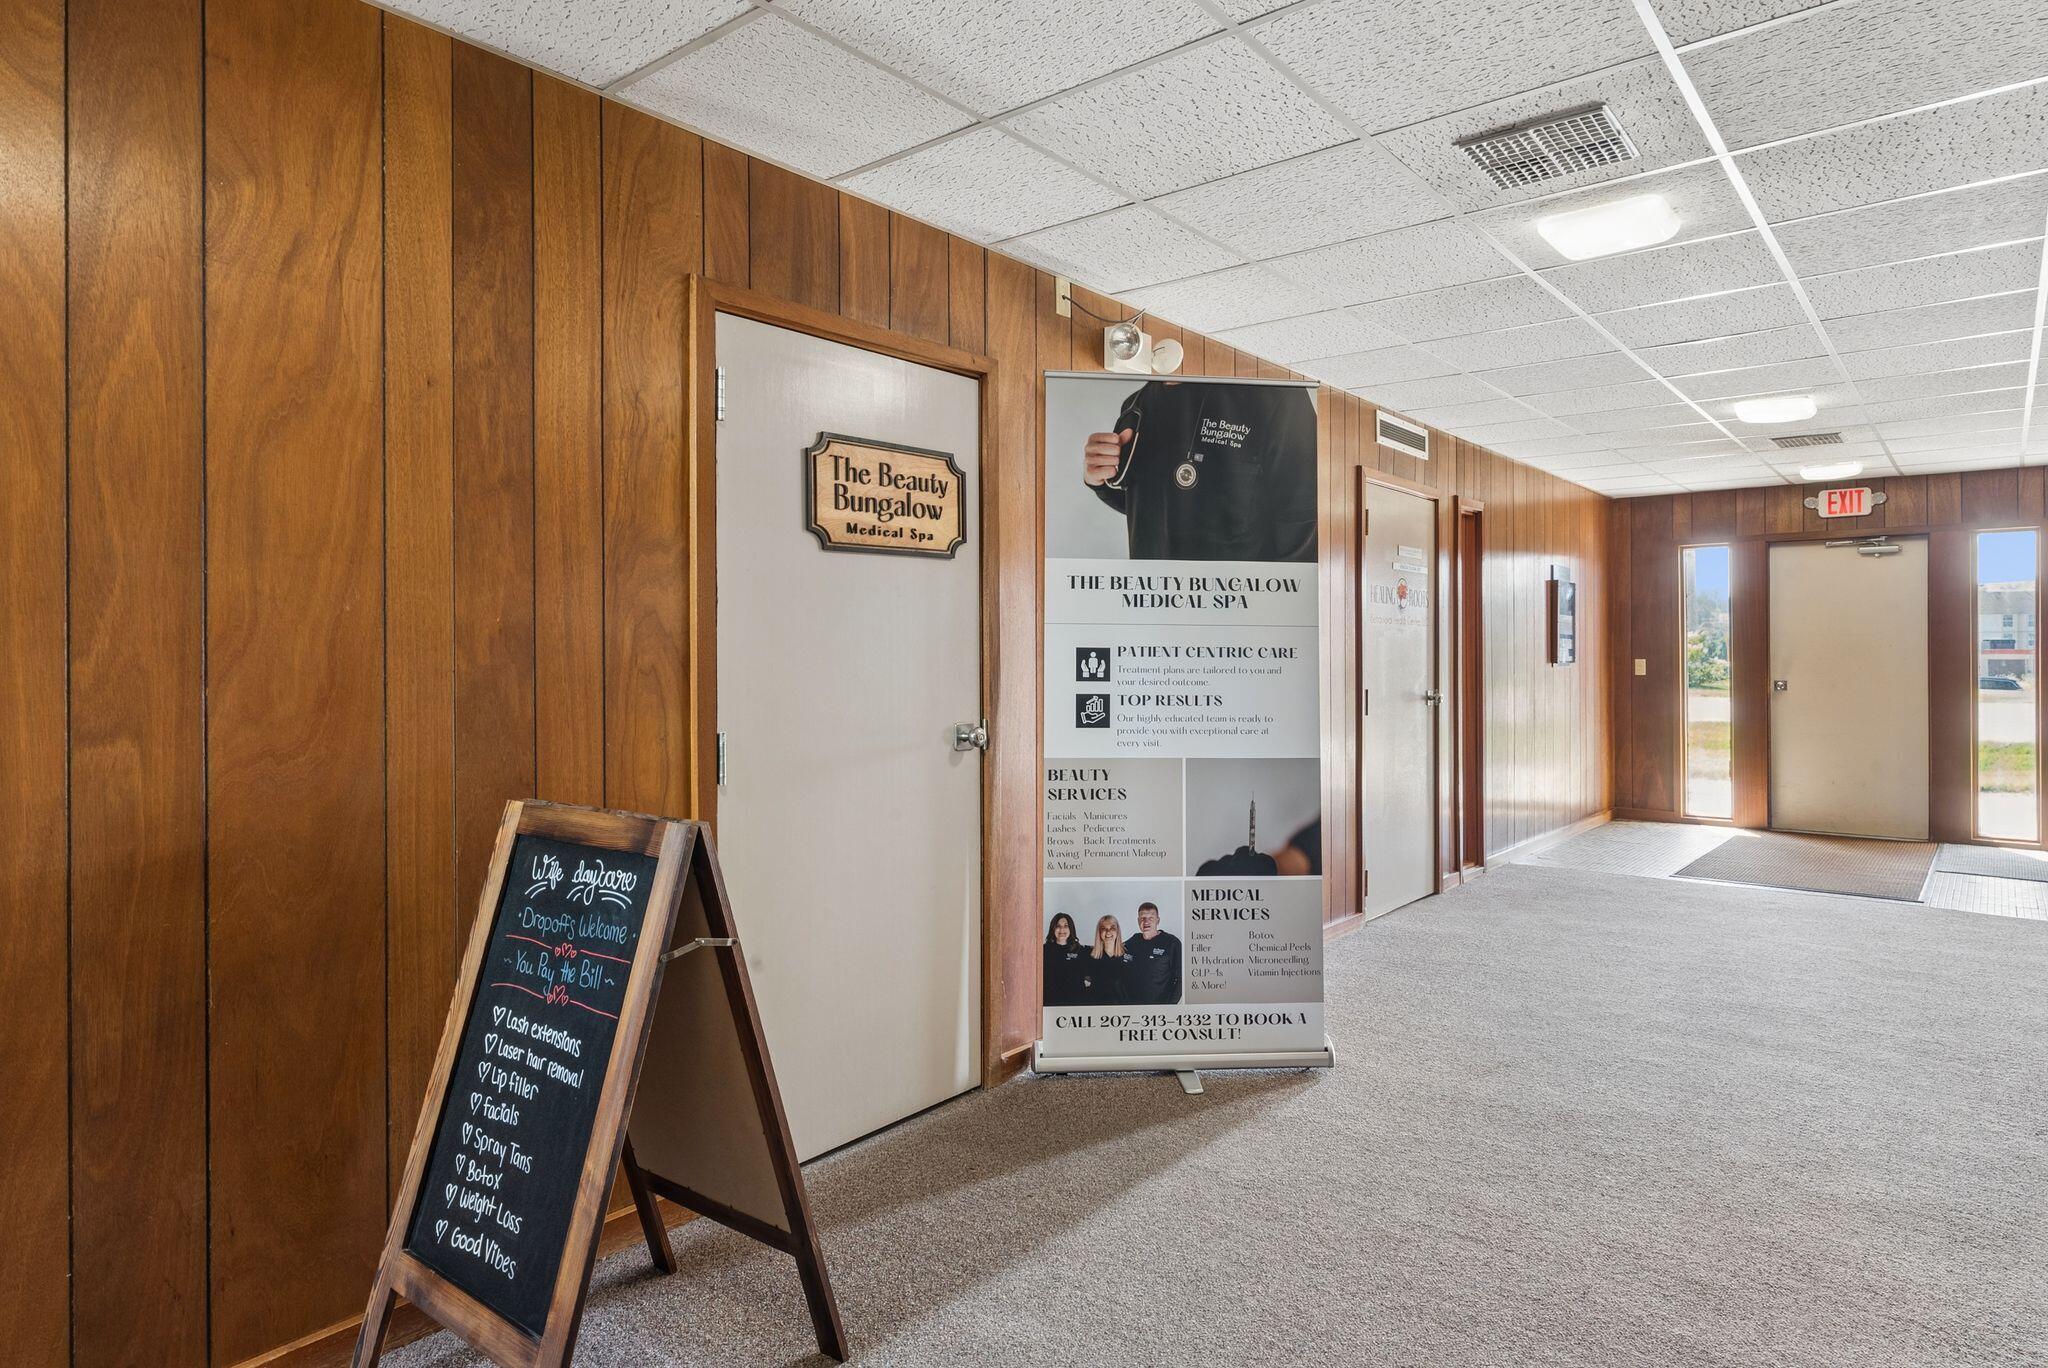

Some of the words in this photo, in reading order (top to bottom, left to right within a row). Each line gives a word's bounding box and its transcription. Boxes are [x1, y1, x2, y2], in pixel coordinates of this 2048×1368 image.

[1202, 418, 1217, 428] The
[1219, 420, 1251, 435] Beauty
[1200, 427, 1245, 440] Bungalow
[1201, 436, 1228, 445] Medical
[829, 454, 871, 485] The
[879, 462, 948, 498] Beauty
[834, 483, 943, 522] Bungalow
[1827, 489, 1864, 515] EXIT
[846, 522, 903, 538] Medical
[910, 528, 934, 542] Spa
[1067, 575, 1105, 590] THE
[1110, 576, 1185, 591] BEAUTY
[1189, 577, 1302, 593] BUNGALOW
[1121, 593, 1207, 609] MEDICAL
[1212, 594, 1249, 609] SPA
[1118, 646, 1181, 658] PATIENT
[1185, 646, 1254, 658] CENTRIC
[1258, 647, 1298, 659] CARE
[1118, 665, 1160, 674] Treatment
[1163, 666, 1185, 675] plans
[1203, 666, 1236, 674] tailored
[1250, 669, 1265, 677] you
[1117, 680, 1135, 688] your
[1138, 677, 1170, 686] desired
[1117, 694, 1151, 706] TOP
[1155, 694, 1223, 707] RESULTS
[1117, 713, 1134, 722] Our
[1137, 714, 1161, 724] highly
[1164, 714, 1204, 722] educated
[1229, 715, 1236, 723] is
[1238, 714, 1261, 724] ready
[1117, 727, 1150, 736] provide
[1152, 729, 1167, 737] you
[1170, 727, 1187, 735] with
[1189, 727, 1238, 736] exceptional
[1117, 740, 1140, 748] every
[1047, 769, 1111, 781] BEAUTY
[1047, 788, 1127, 801] SERVICES
[1047, 812, 1077, 820] Facials
[1083, 811, 1128, 820] Manicures
[1047, 824, 1077, 832] Lashes
[1083, 824, 1125, 832] Pedicures
[1047, 837, 1074, 845] Brows
[1083, 837, 1105, 845] Back
[1108, 837, 1156, 845] Treatments
[1047, 849, 1079, 859] Waxing
[1084, 849, 1130, 858] Permanent
[1132, 849, 1167, 859] Makeup
[1046, 862, 1055, 870] &
[1057, 862, 1083, 870] More!
[531, 854, 565, 890] Wife
[571, 859, 637, 905] daycare
[1191, 889, 1264, 901] MEDICAL
[1191, 908, 1270, 921] SERVICES
[522, 906, 576, 940] Dropoffs
[579, 914, 628, 944] Welcome
[1191, 931, 1214, 940] Laser
[1248, 931, 1274, 939] Botox
[1191, 944, 1211, 952] Filler
[1248, 943, 1287, 952] Chemical
[1289, 942, 1311, 951] Peels
[1191, 956, 1199, 964] IV
[1201, 956, 1244, 965] Hydration
[515, 950, 533, 975] You
[537, 952, 555, 996] Pay
[560, 960, 576, 983] the
[579, 959, 603, 990] Bill
[1248, 968, 1279, 977] Vitamin
[1281, 968, 1321, 978] Injections
[1191, 981, 1199, 989] &
[1201, 980, 1227, 989] More!
[1056, 1015, 1095, 1028] CALL
[1100, 1015, 1211, 1027] 207-313-1332
[1217, 1013, 1239, 1026] TO
[1243, 1013, 1294, 1025] BOOK
[1298, 1013, 1307, 1024] A
[530, 1023, 582, 1058] extensions
[1119, 1029, 1157, 1041] FREE
[1162, 1028, 1241, 1041] CONSULT!
[497, 1038, 525, 1061] Laser
[526, 1047, 547, 1070] hair
[546, 1060, 584, 1089] removal
[491, 1066, 507, 1093] Lip
[508, 1071, 539, 1101] filler
[473, 1127, 507, 1168] Spray
[508, 1142, 533, 1174] Tans
[465, 1159, 503, 1190] Botox
[459, 1187, 496, 1223] Weight
[496, 1203, 522, 1234] Loss
[451, 1226, 484, 1258] Good
[484, 1238, 517, 1280] Vibes
